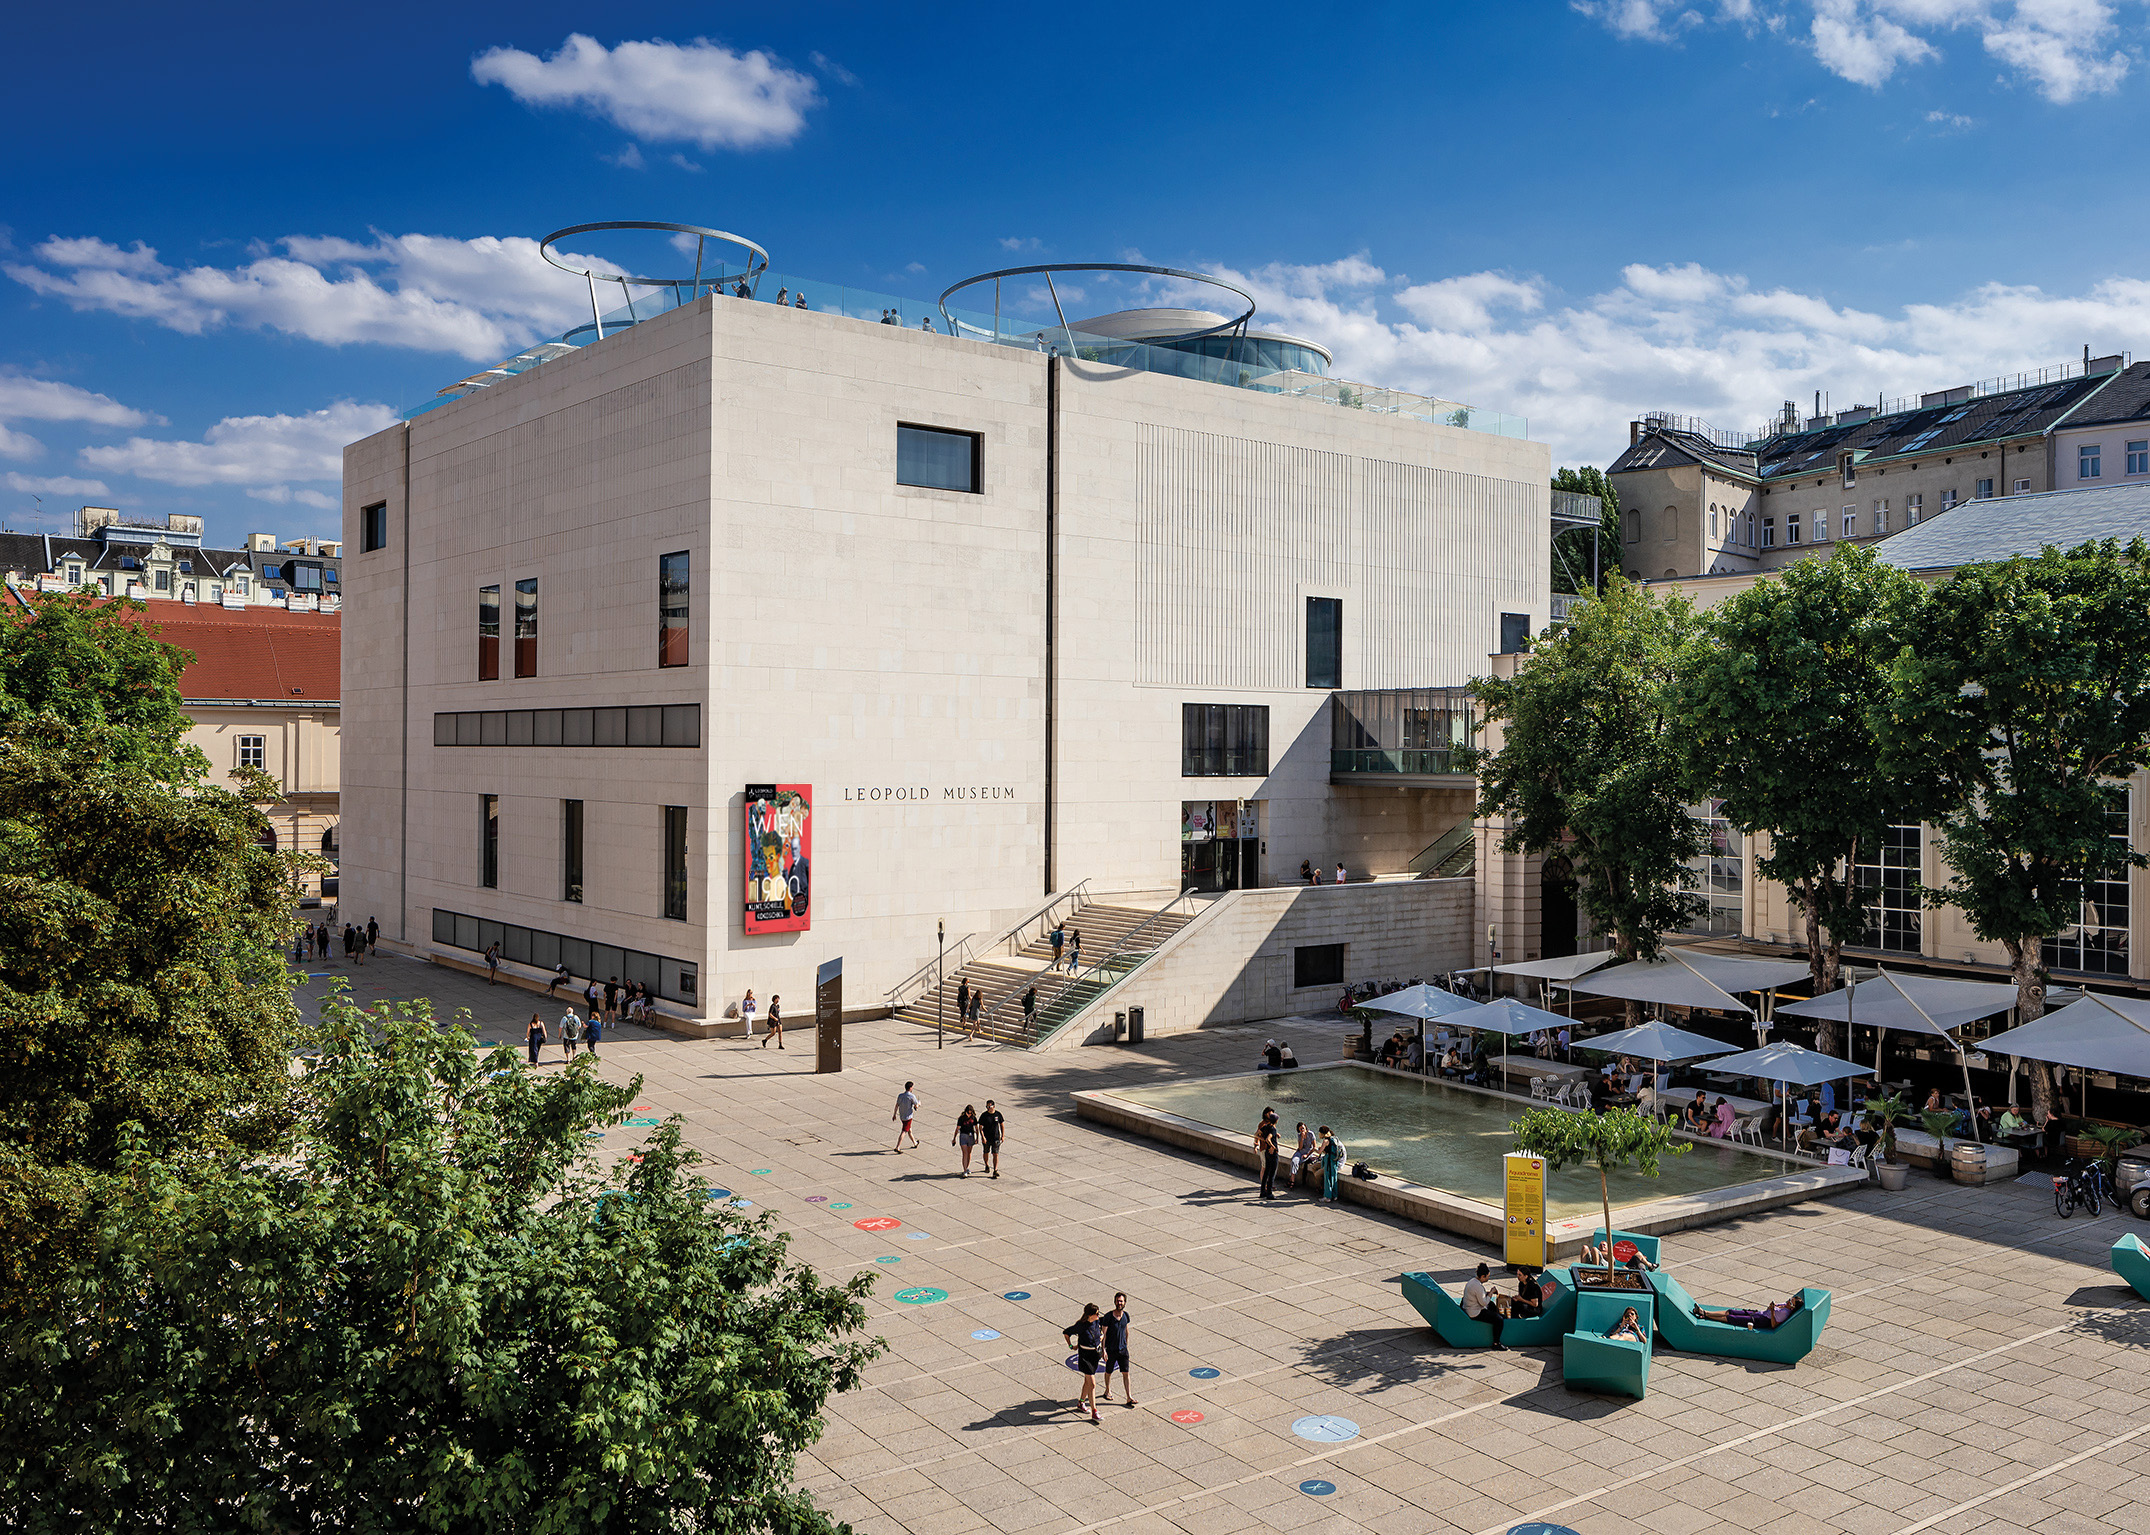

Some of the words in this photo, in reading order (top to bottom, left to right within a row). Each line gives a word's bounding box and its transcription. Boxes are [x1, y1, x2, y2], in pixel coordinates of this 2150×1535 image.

[844, 787, 930, 801] LEOPOLD
[943, 786, 1015, 800] MUSEUM
[752, 813, 803, 838] WIEN
[754, 875, 800, 903] 1900
